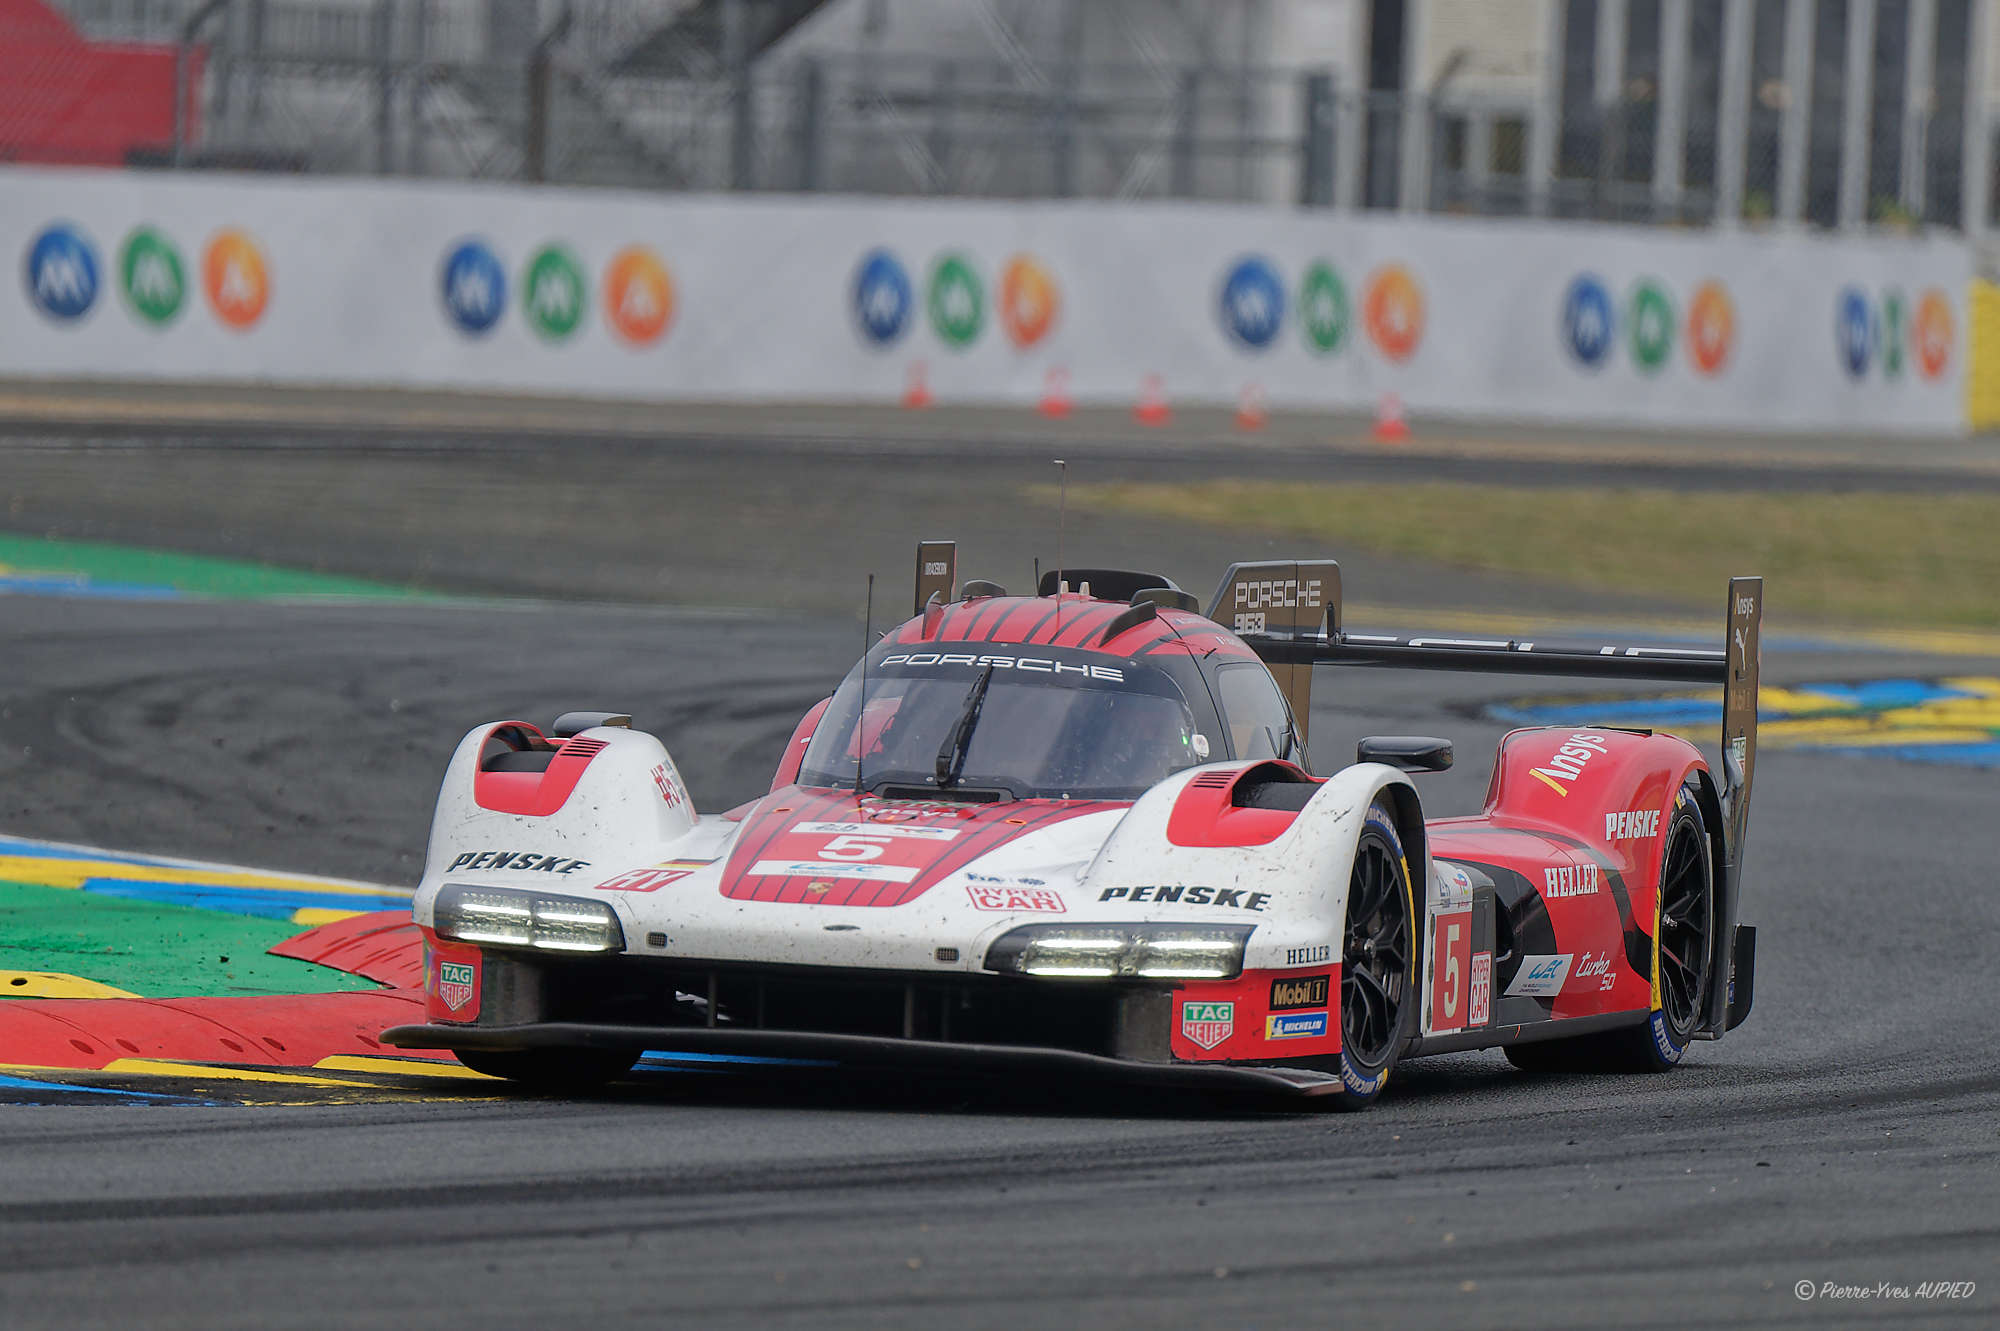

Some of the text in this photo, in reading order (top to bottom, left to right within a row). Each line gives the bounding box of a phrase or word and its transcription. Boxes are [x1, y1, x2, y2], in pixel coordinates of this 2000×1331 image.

[1234, 580, 1321, 609] PORSCHE
[1234, 612, 1266, 636] 963
[879, 653, 1125, 682] PORSCHE
[1529, 733, 1608, 798] Ansys
[1605, 809, 1661, 841] PENSKE
[817, 835, 893, 862] 5
[446, 850, 592, 874] PENSKE
[974, 887, 1052, 898] HYPER
[1543, 863, 1600, 898] HELLER
[978, 895, 1058, 910] CAR
[1098, 885, 1272, 912] PENSKE
[1286, 944, 1331, 965] HELLER
[1575, 951, 1611, 978] turbo
[443, 966, 471, 983] TAG
[1443, 924, 1460, 1019] 5
[1472, 958, 1490, 983] HYPER
[1599, 972, 1617, 991] 50
[441, 984, 470, 1006] HEUER
[1273, 981, 1311, 1006] Mobil
[1471, 983, 1489, 1020] CAR
[1188, 1005, 1230, 1020] TAG
[1185, 1022, 1230, 1046] HEUER
[1283, 1019, 1323, 1033] MICHELIN
